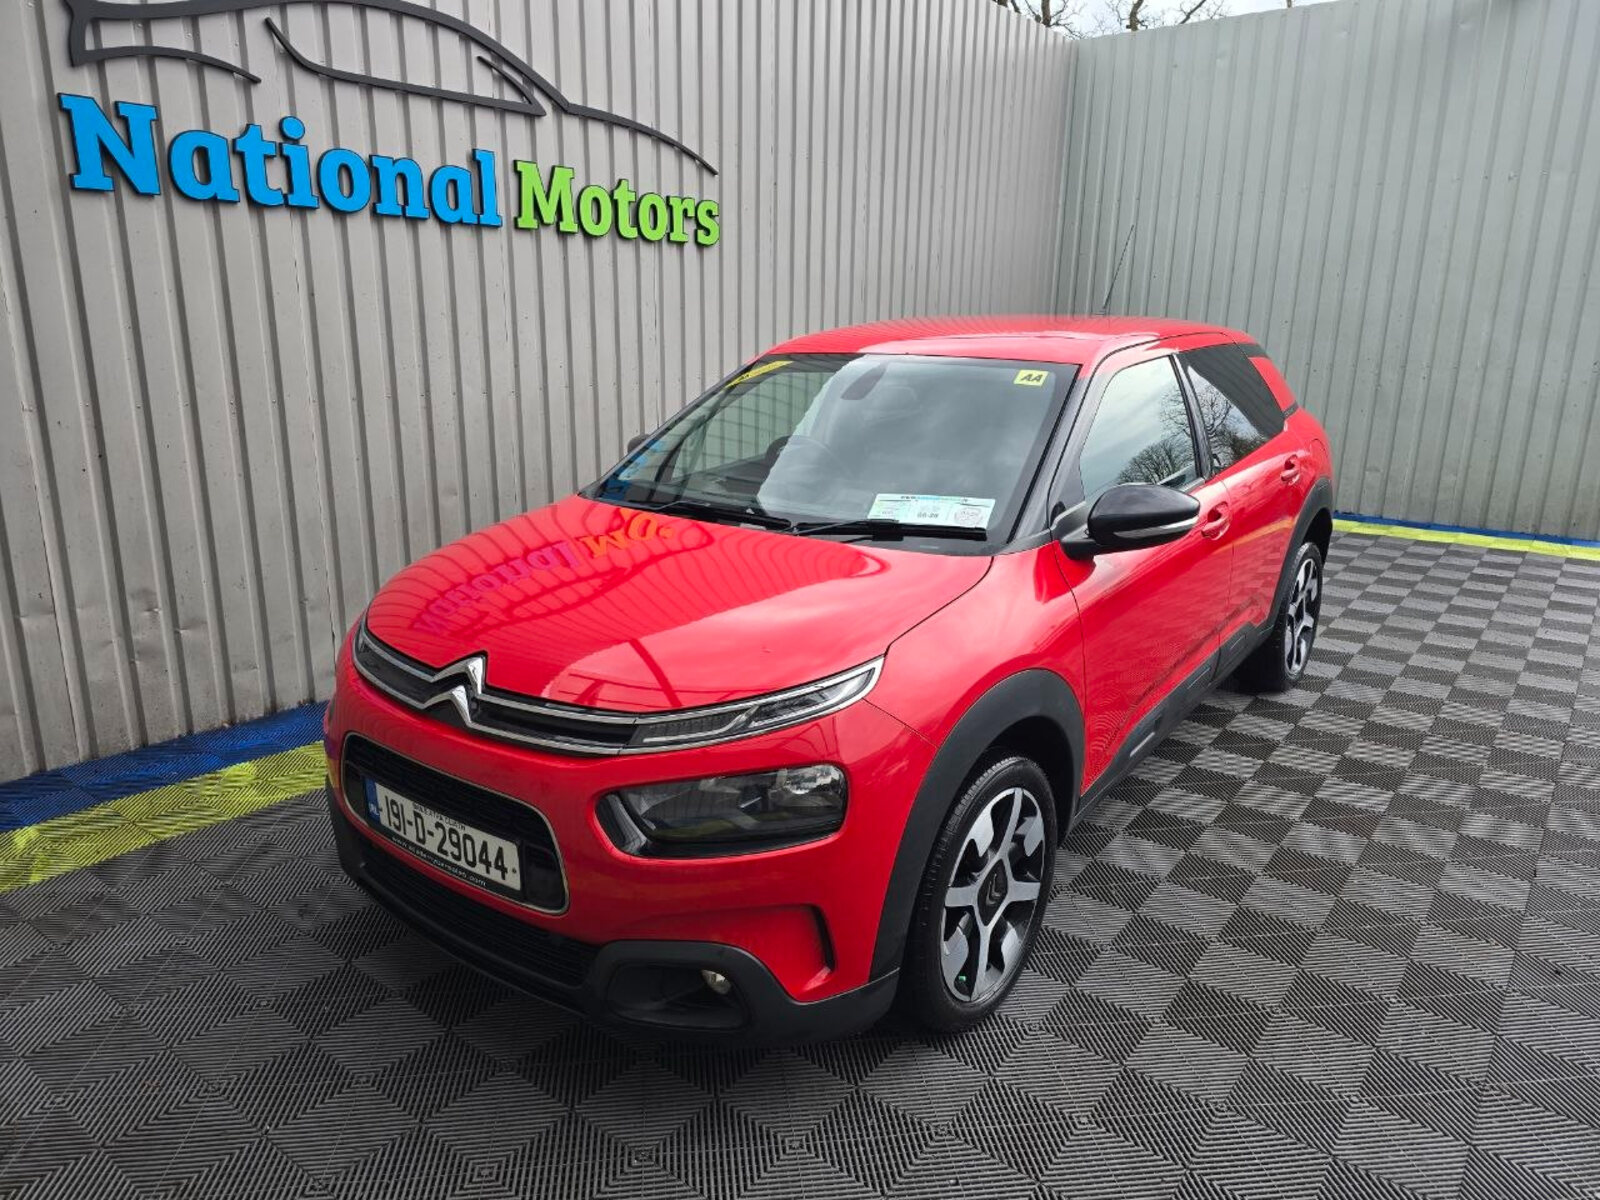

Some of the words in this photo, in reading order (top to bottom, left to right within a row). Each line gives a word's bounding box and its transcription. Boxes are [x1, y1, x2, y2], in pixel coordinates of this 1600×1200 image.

[58, 92, 503, 227] National
[514, 160, 721, 247] Motors
[1020, 373, 1043, 382] AA
[384, 795, 508, 880] 191-D-29044
